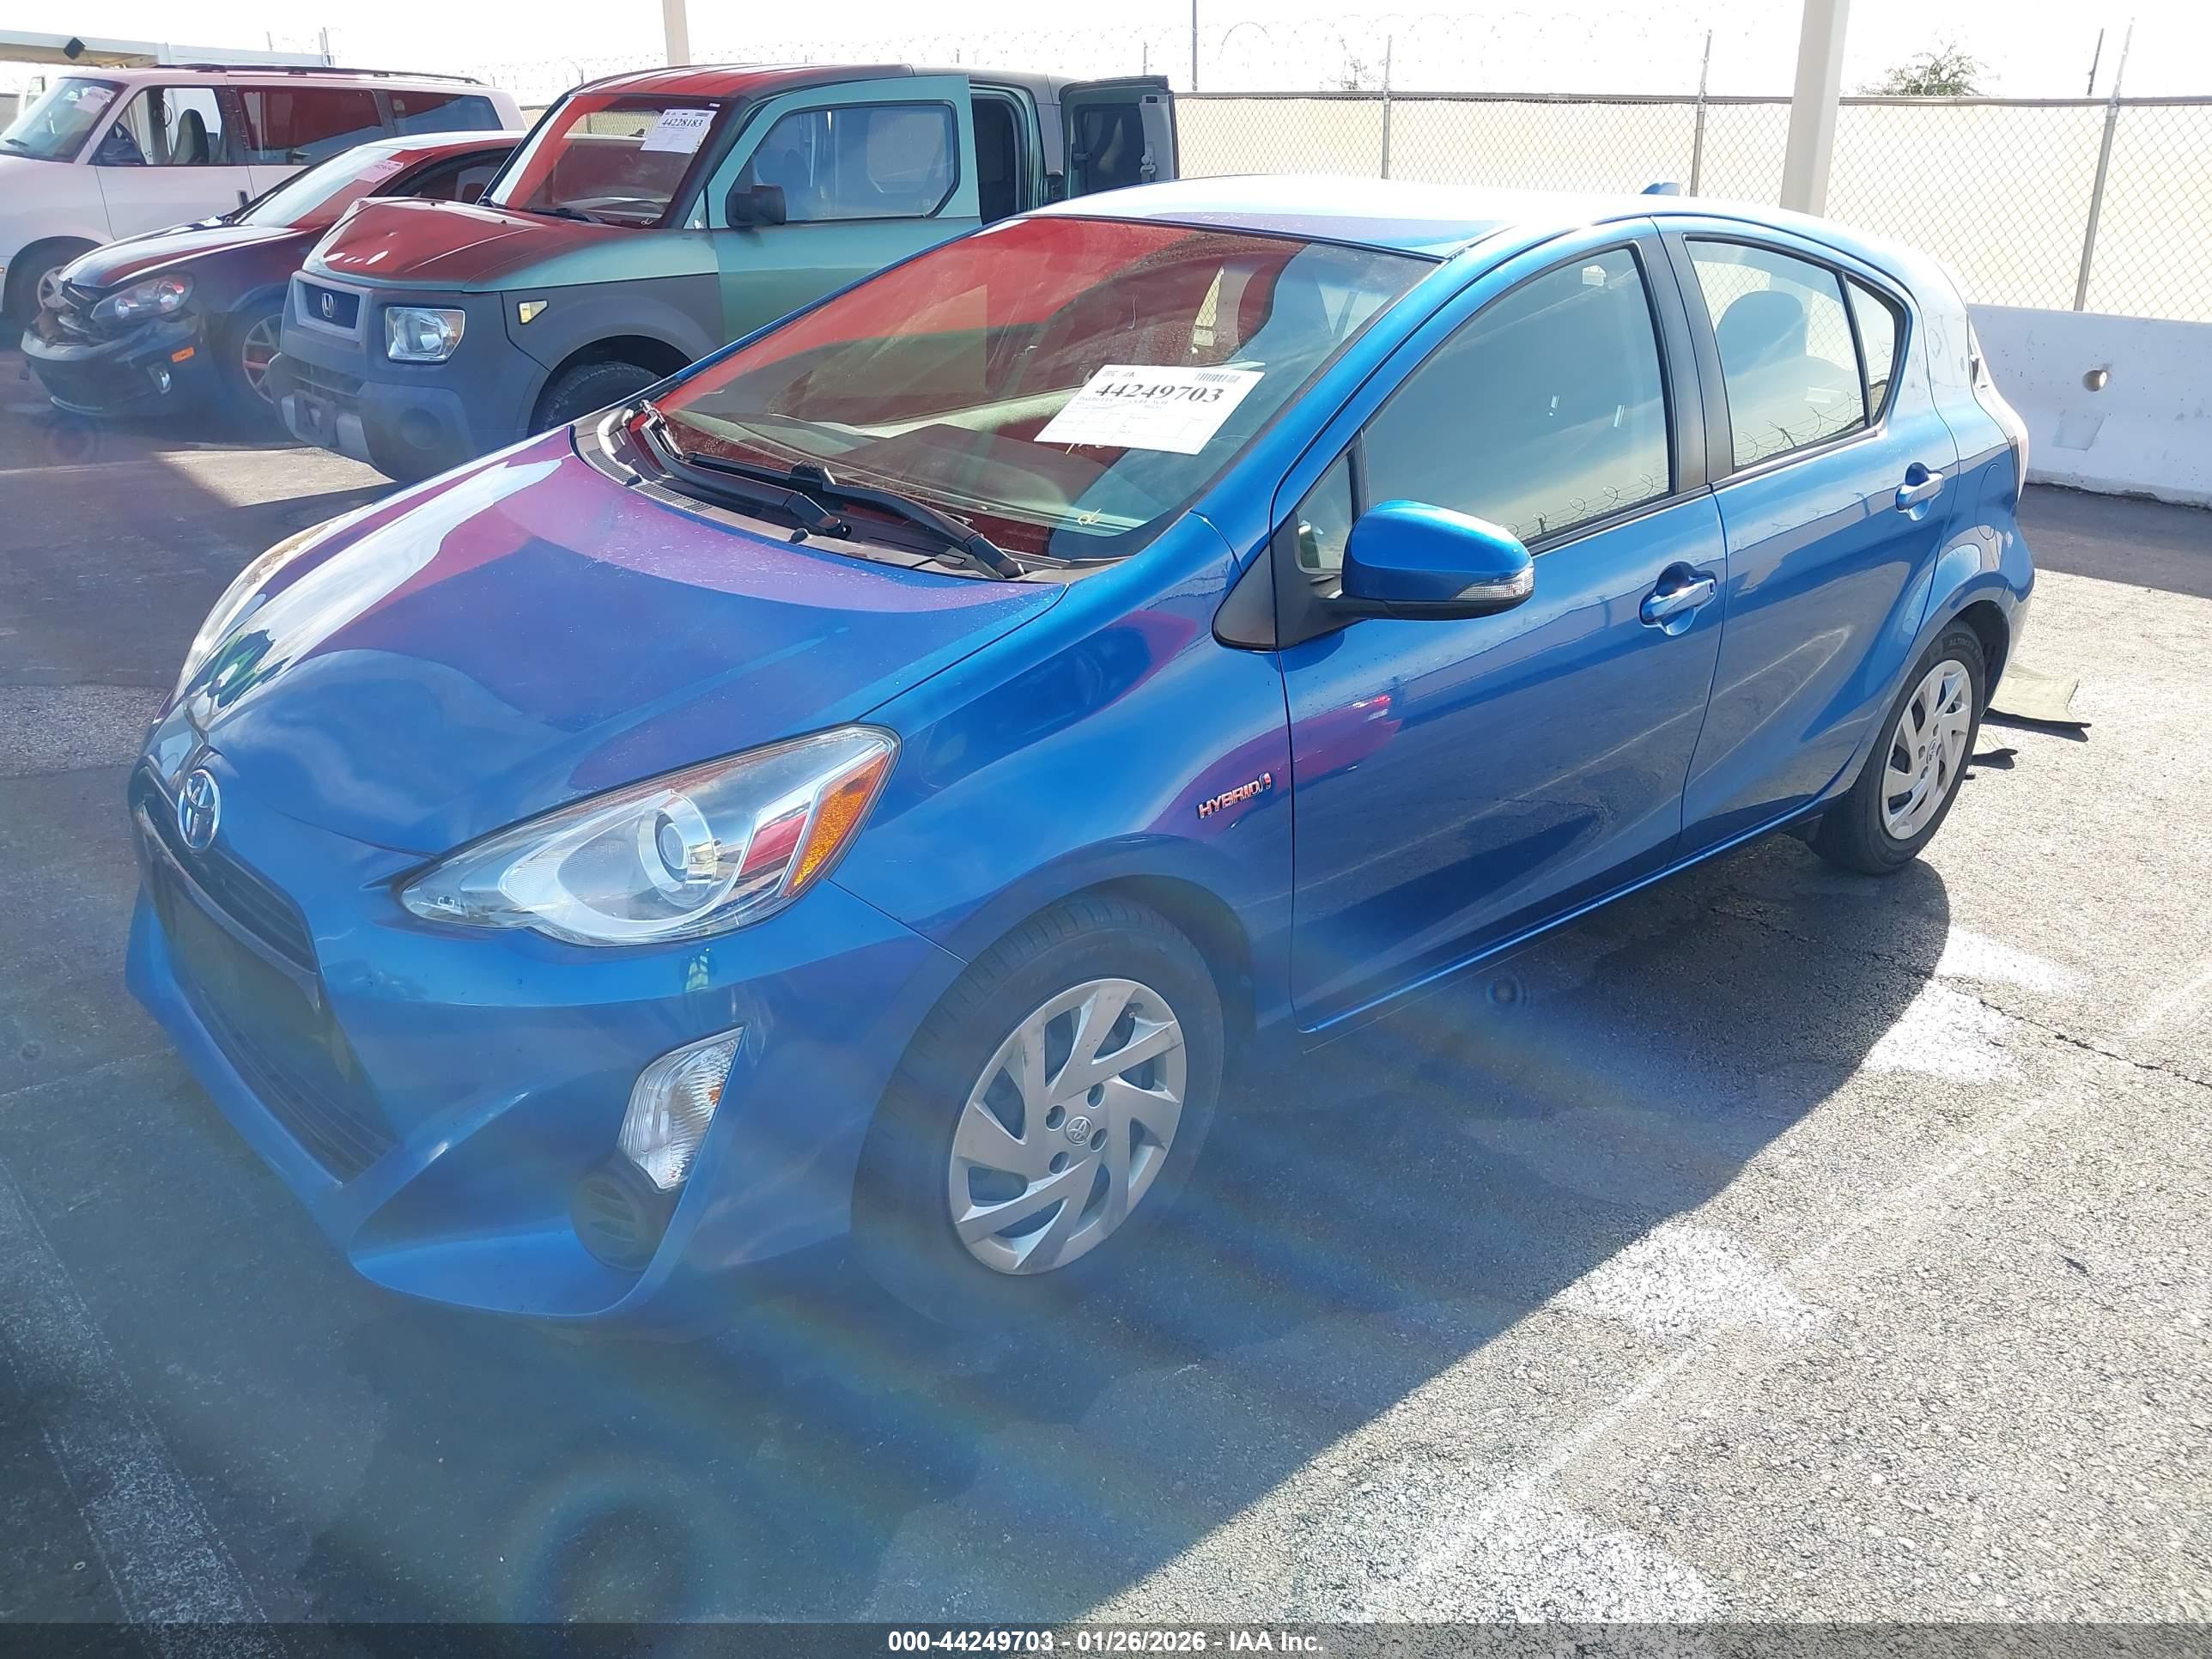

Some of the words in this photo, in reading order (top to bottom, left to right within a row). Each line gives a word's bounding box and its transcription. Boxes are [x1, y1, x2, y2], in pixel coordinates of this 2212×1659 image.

[662, 118, 703, 128] 44228183
[1095, 382, 1224, 403] 44249703
[1199, 780, 1261, 818] HYBRID
